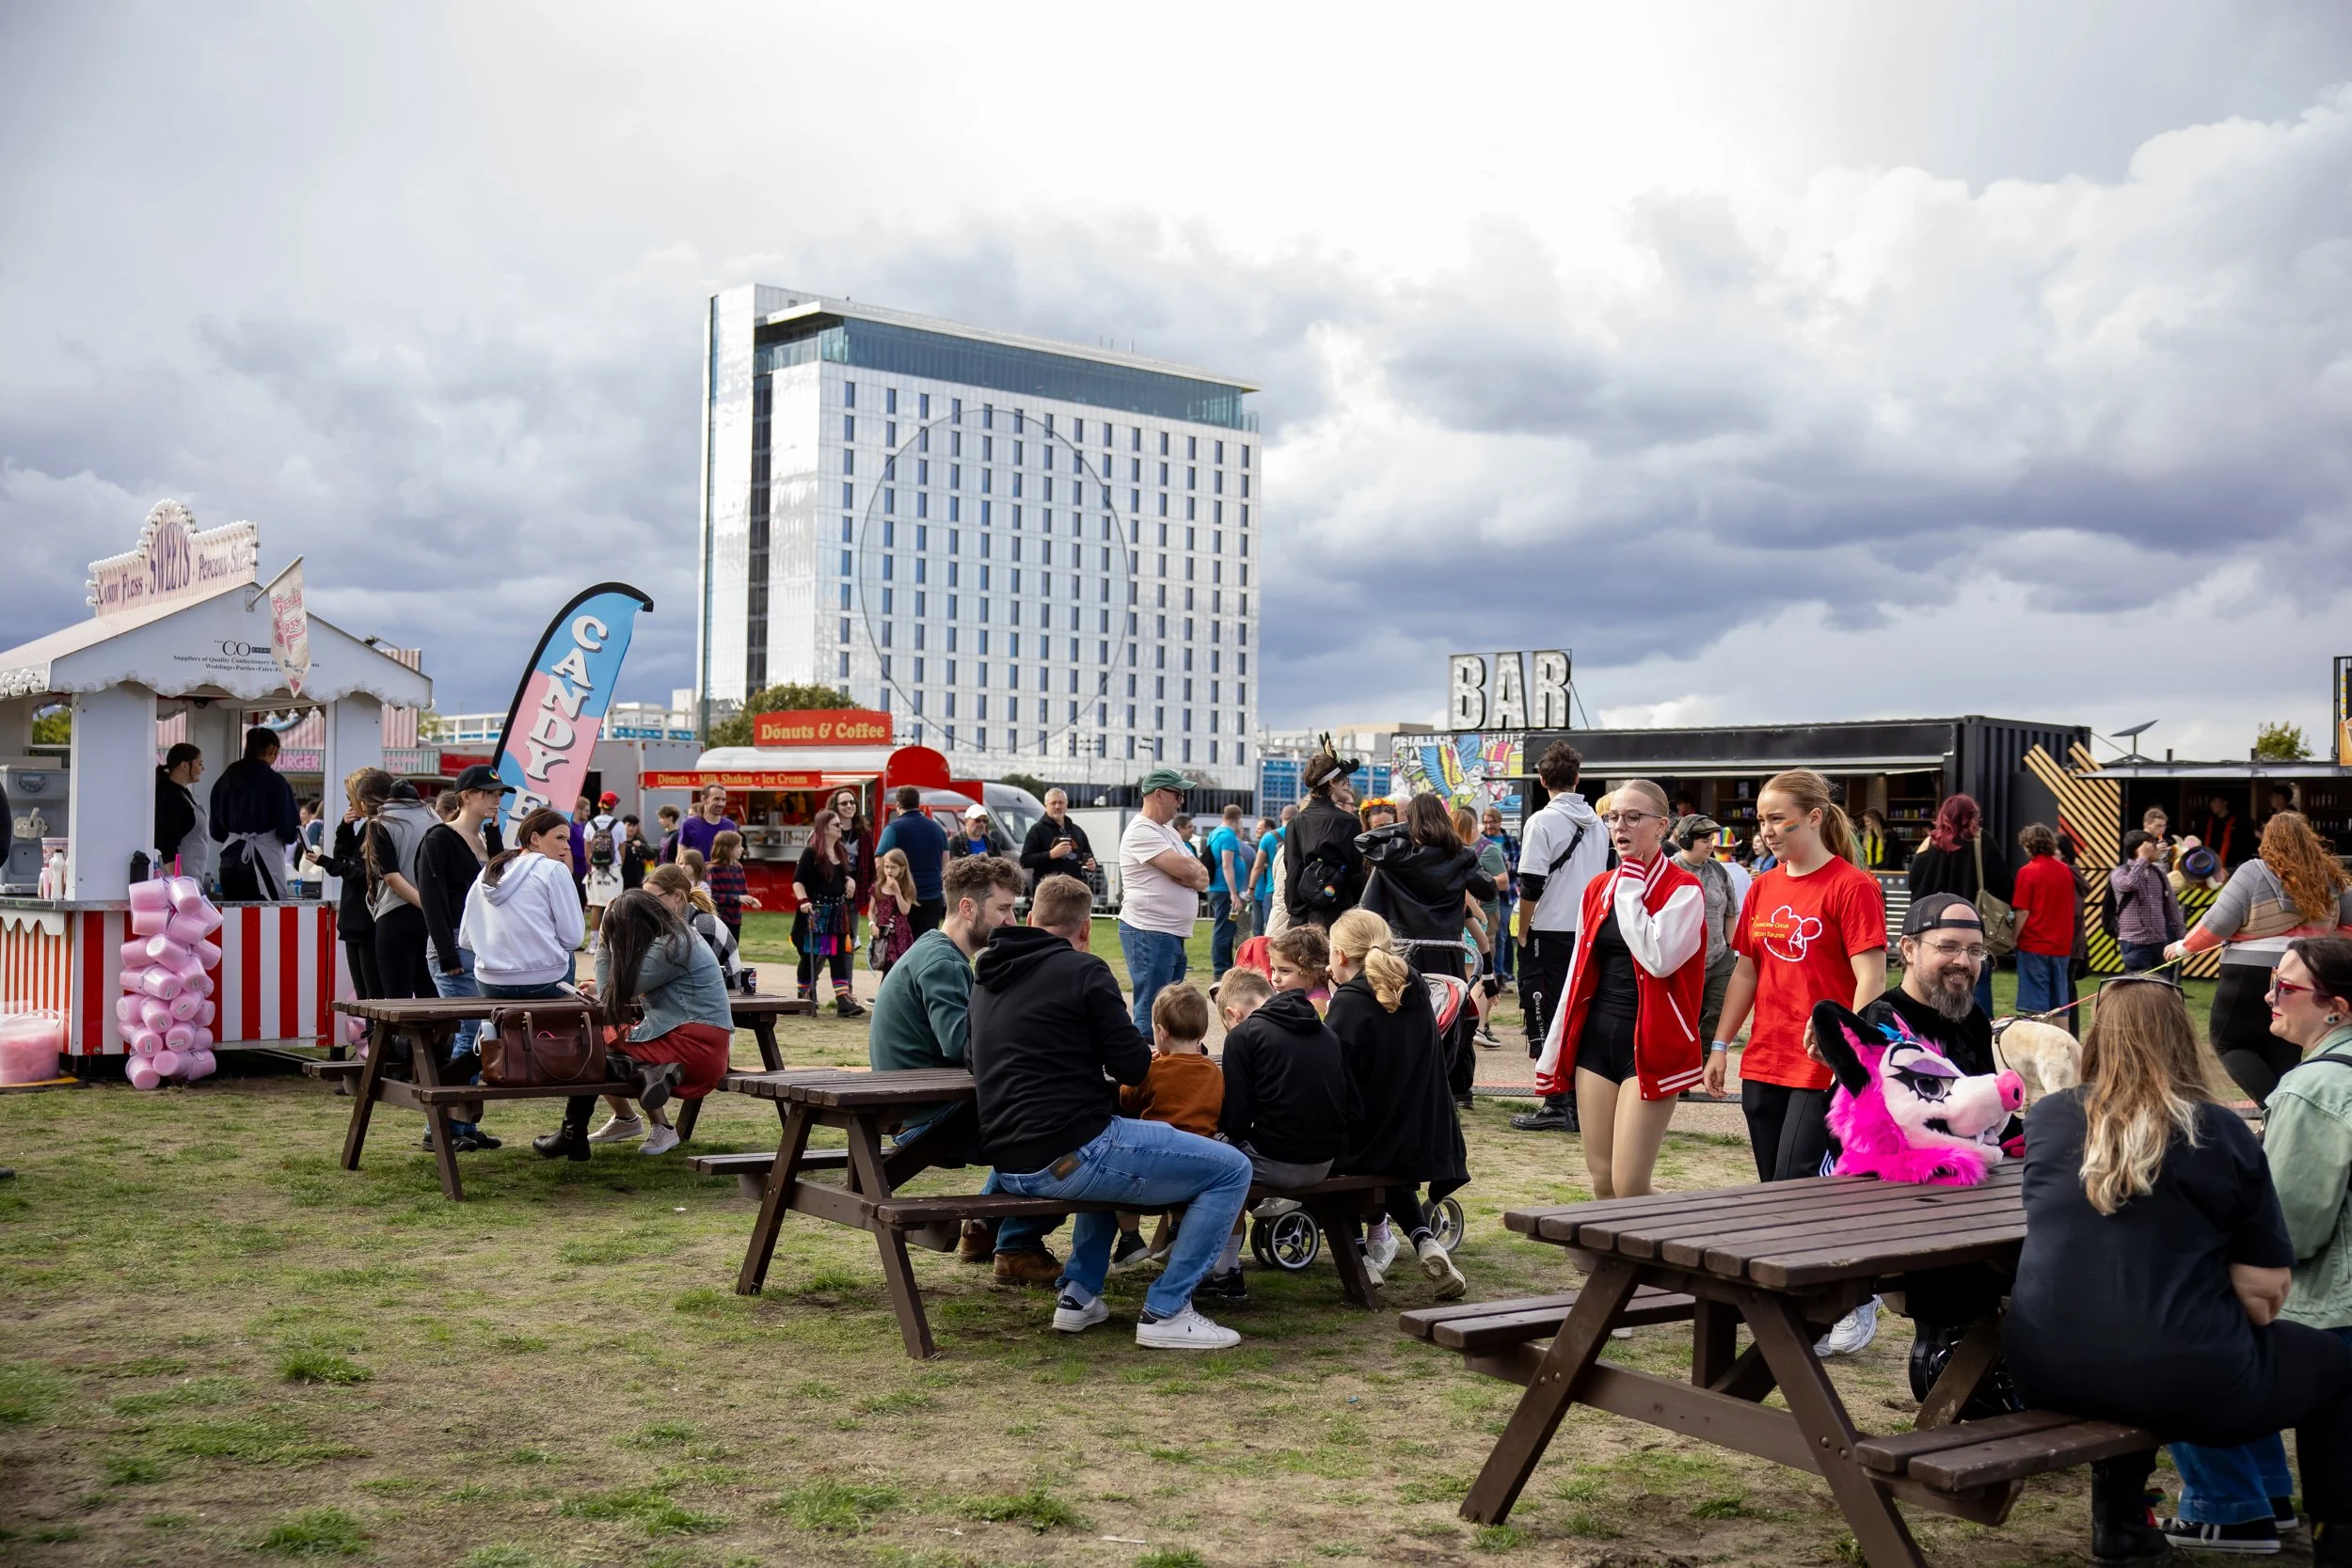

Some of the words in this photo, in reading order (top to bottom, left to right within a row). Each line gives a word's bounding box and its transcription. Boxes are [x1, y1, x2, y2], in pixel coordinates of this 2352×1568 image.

[150, 522, 190, 594] SWEETS
[525, 615, 609, 783] CANDY
[1449, 651, 1570, 730] BAR
[818, 722, 832, 738] &
[835, 722, 885, 738] Coffee
[272, 754, 319, 769] URGER
[721, 773, 753, 784] Shakes
[761, 773, 776, 784] Ice
[777, 773, 807, 784] Cream
